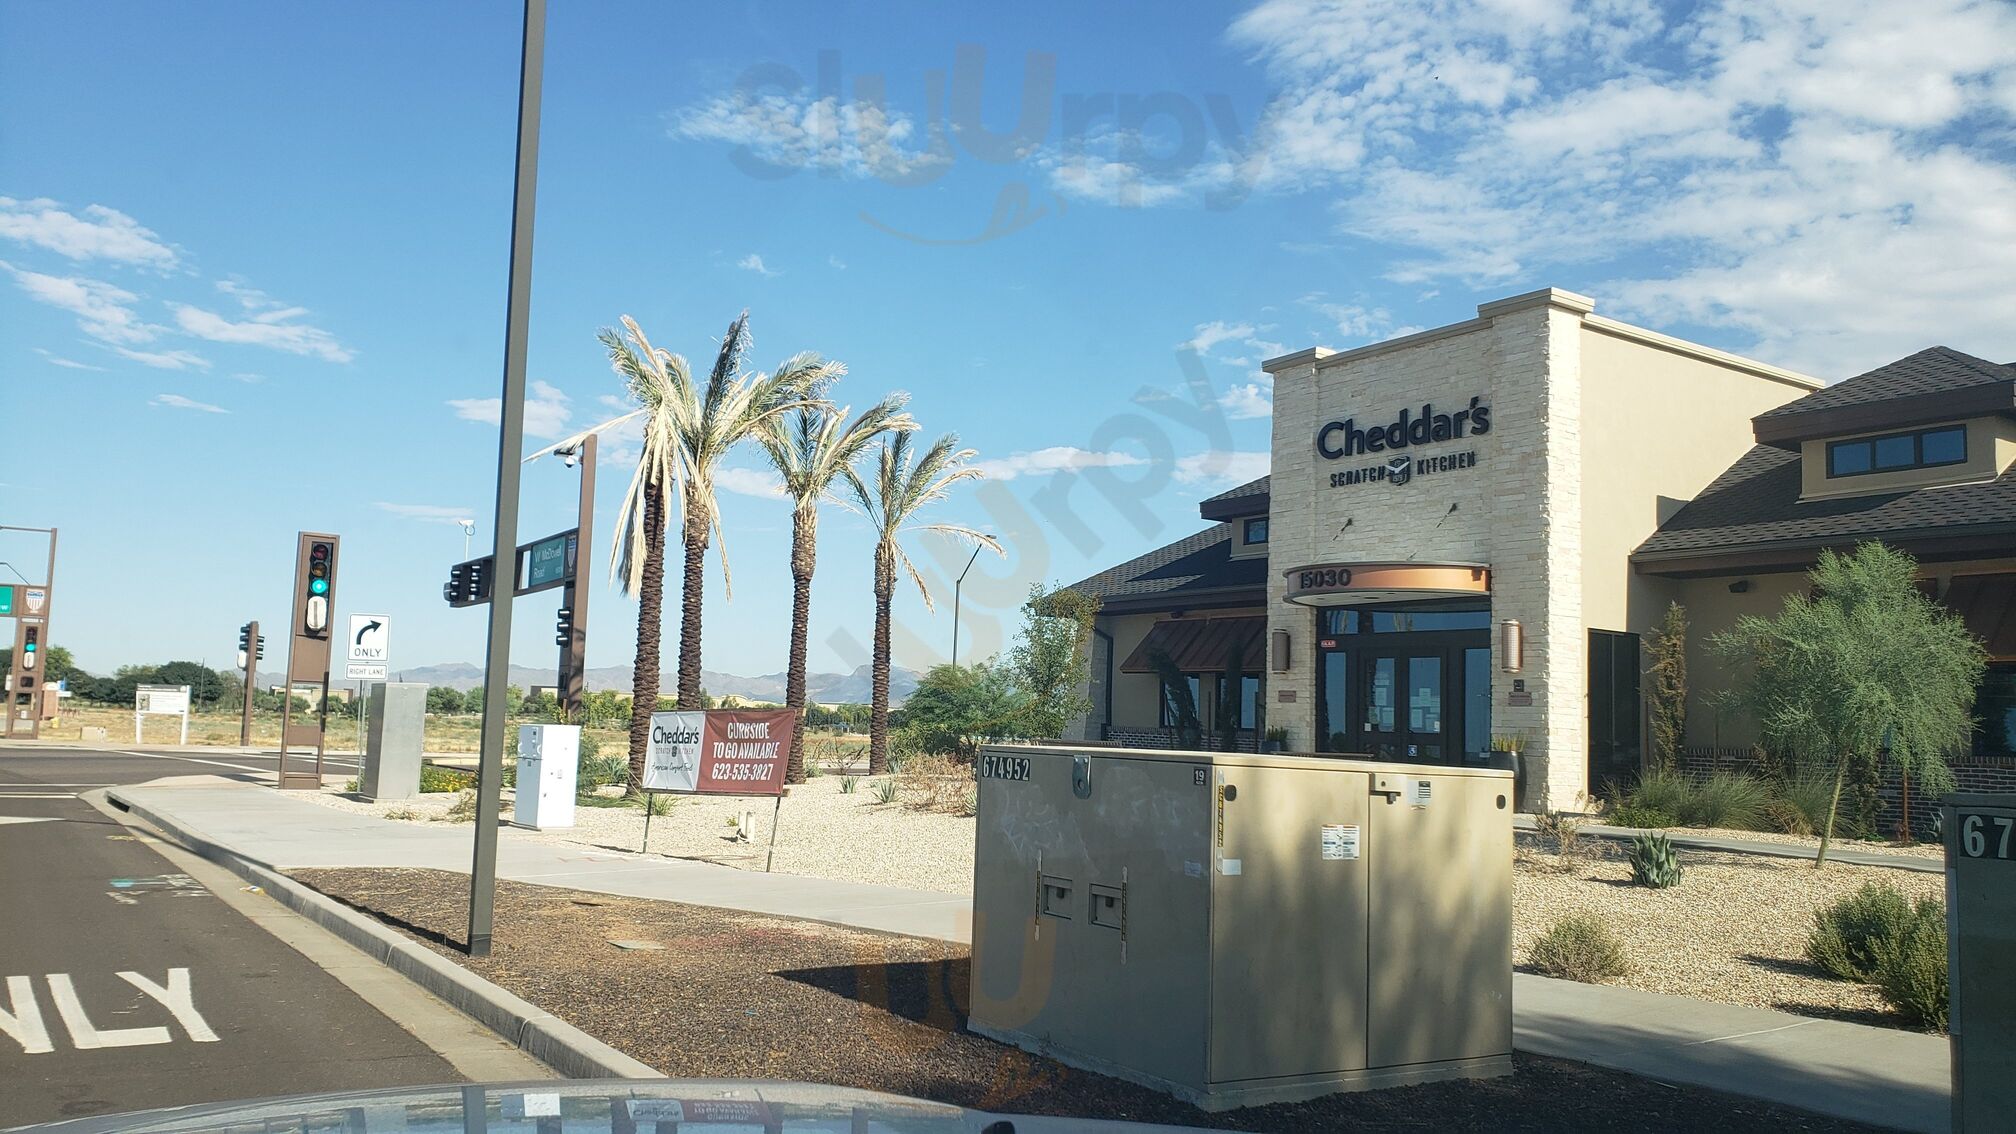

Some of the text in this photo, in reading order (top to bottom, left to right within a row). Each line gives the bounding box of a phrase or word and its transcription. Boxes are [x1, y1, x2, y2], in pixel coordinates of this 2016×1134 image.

[1317, 396, 1490, 460] Cheddar's
[1330, 465, 1387, 488] SCRATCH
[1416, 451, 1477, 475] KITCHEN
[1300, 568, 1352, 589] 15030
[354, 647, 382, 658] ONLY
[349, 667, 385, 676] RIGHT LANE
[652, 725, 700, 745] Cheddar's
[727, 722, 770, 739] CURBSIDE
[713, 741, 780, 759] TO GO AVAILABLE
[711, 763, 774, 781] 623-535-3827
[983, 756, 1029, 781] 674952
[1195, 770, 1205, 781] 19
[1963, 815, 2014, 859] 67
